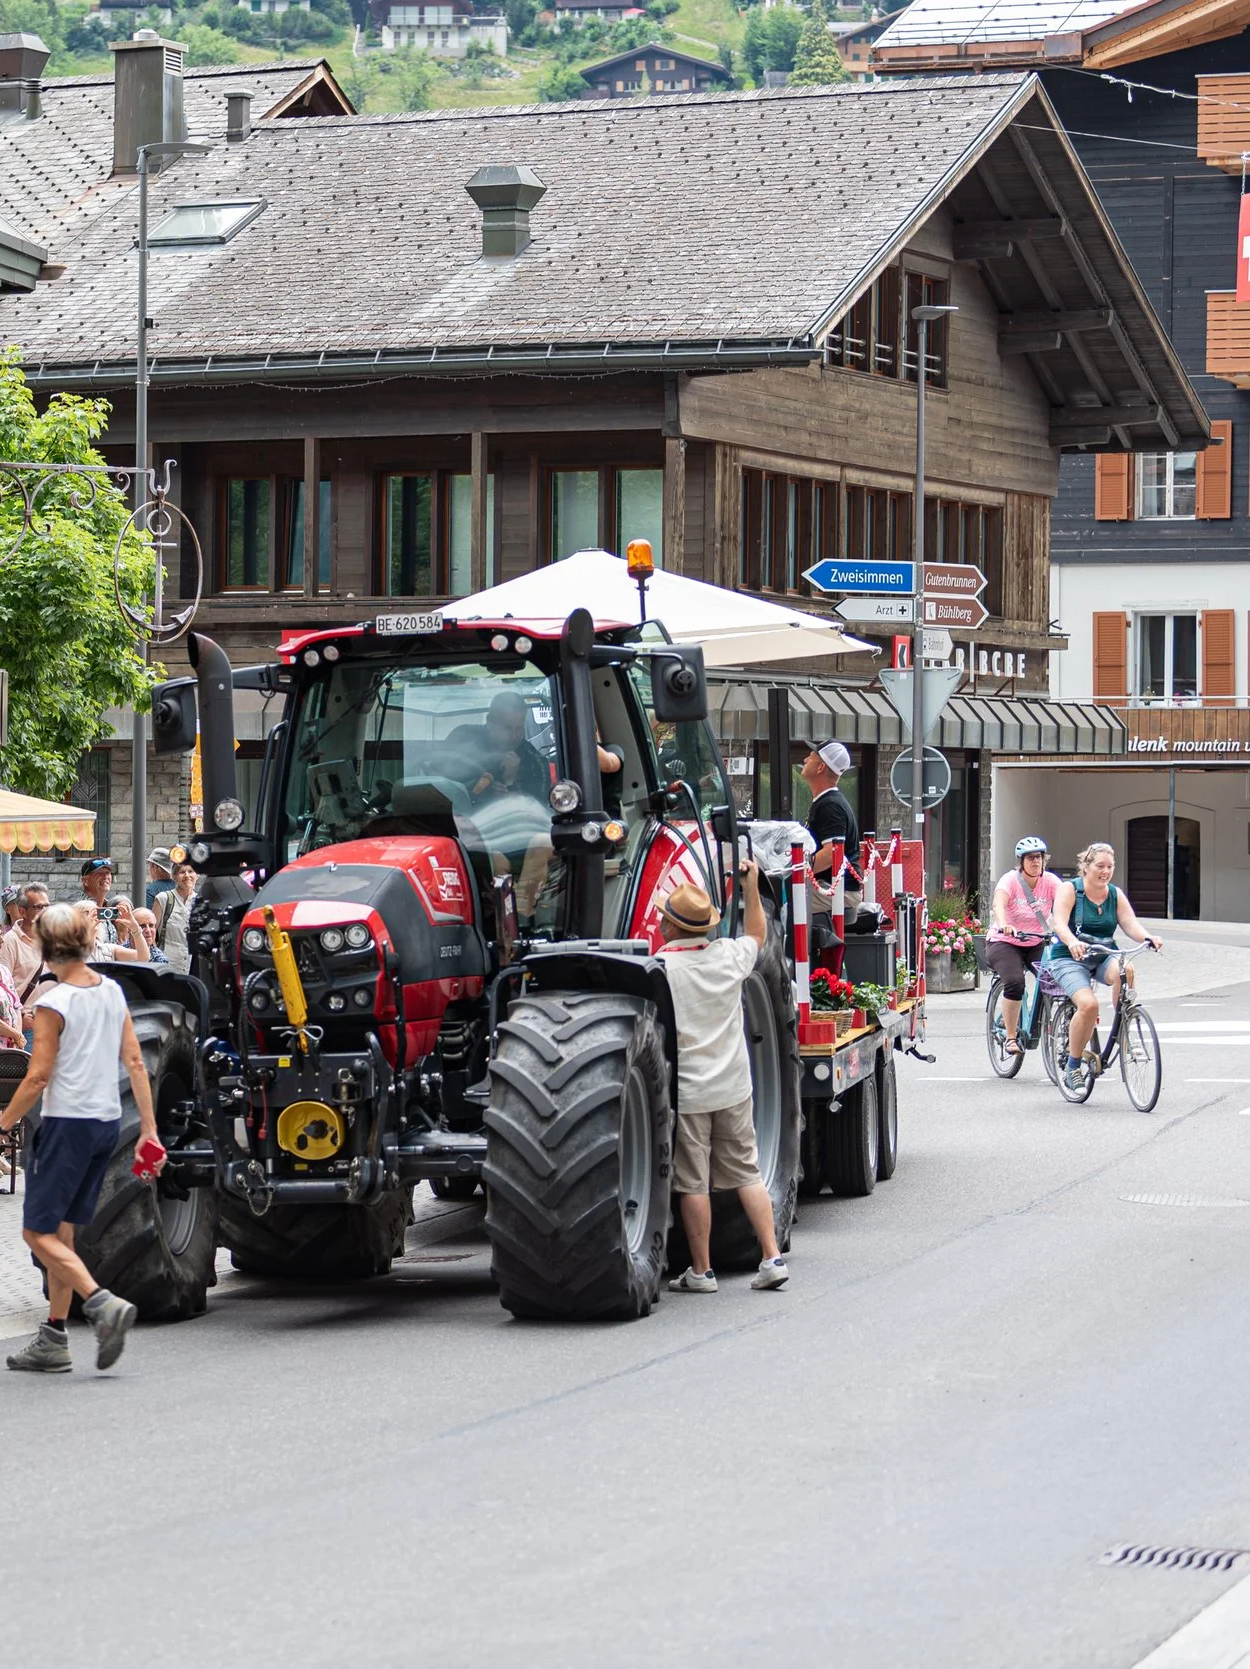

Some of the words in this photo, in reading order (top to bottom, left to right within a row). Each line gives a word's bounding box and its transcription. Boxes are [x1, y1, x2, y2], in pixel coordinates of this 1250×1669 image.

[830, 568, 903, 585] Zweisimmen
[925, 571, 977, 589] Gutenbrunnen
[875, 605, 893, 616] Arzt
[937, 604, 972, 623] Bühlberg
[979, 650, 1026, 679] BCBE
[1172, 738, 1241, 752] mountain
